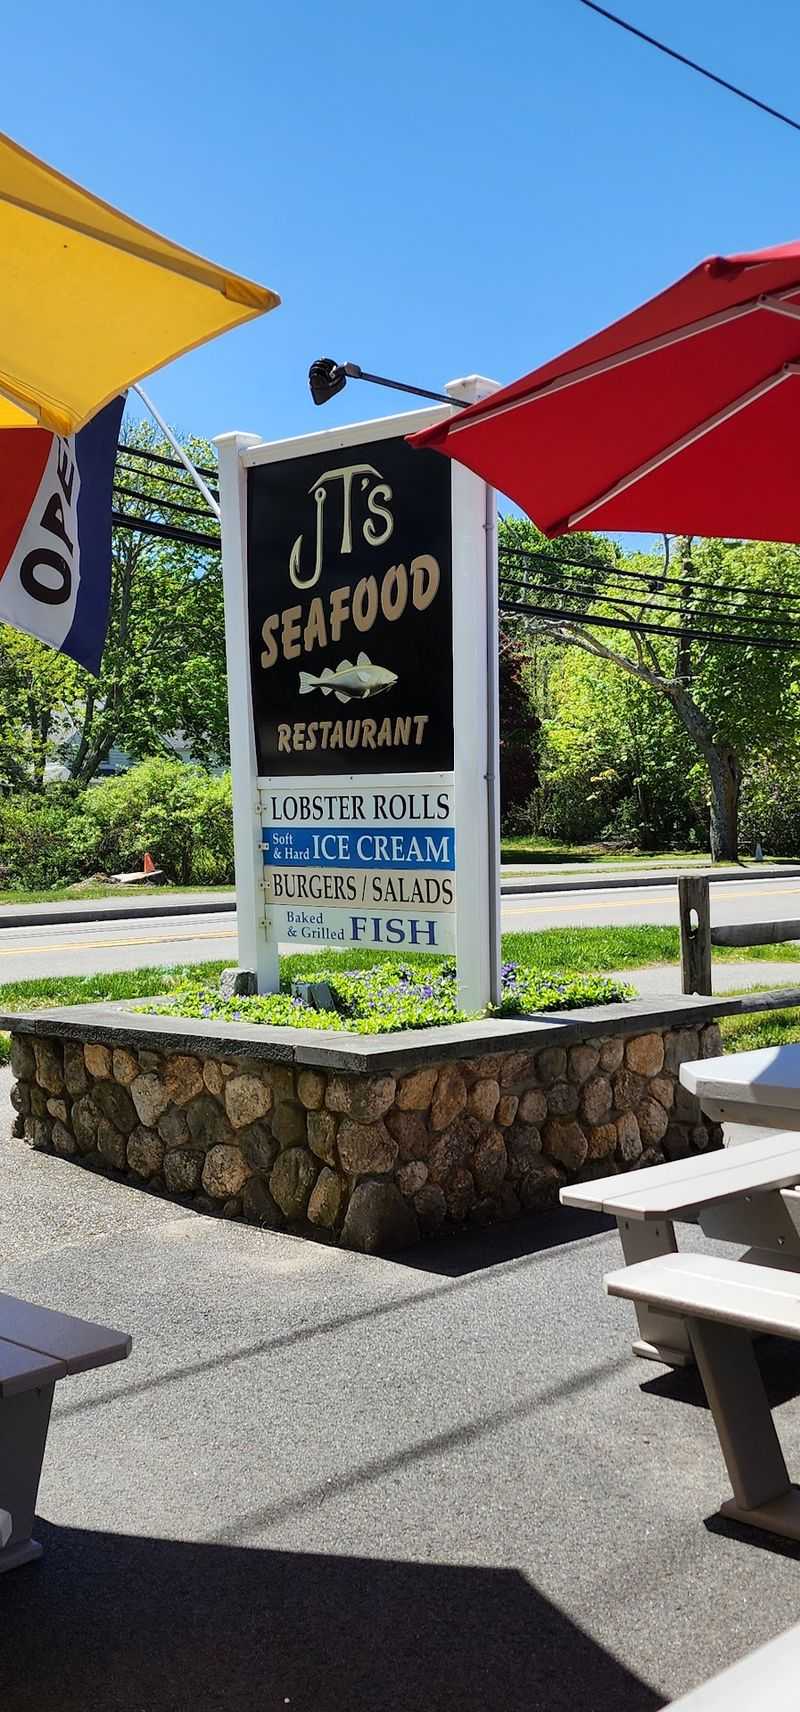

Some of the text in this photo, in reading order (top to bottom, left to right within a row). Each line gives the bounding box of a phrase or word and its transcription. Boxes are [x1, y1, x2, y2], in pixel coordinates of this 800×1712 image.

[20, 435, 75, 605] OPE
[260, 554, 440, 669] SEAFOOD
[276, 715, 429, 753] RESTAURANT
[271, 793, 450, 821] LOBSTER ROLLS
[272, 832, 294, 846] Soft
[311, 834, 450, 863] ICE CREAM
[272, 847, 310, 861] & Hard
[272, 873, 357, 901] BURGERS
[372, 876, 454, 905] SALADS
[287, 911, 324, 924] Baked
[350, 916, 439, 946] FISH
[287, 926, 345, 941] & Grilled
